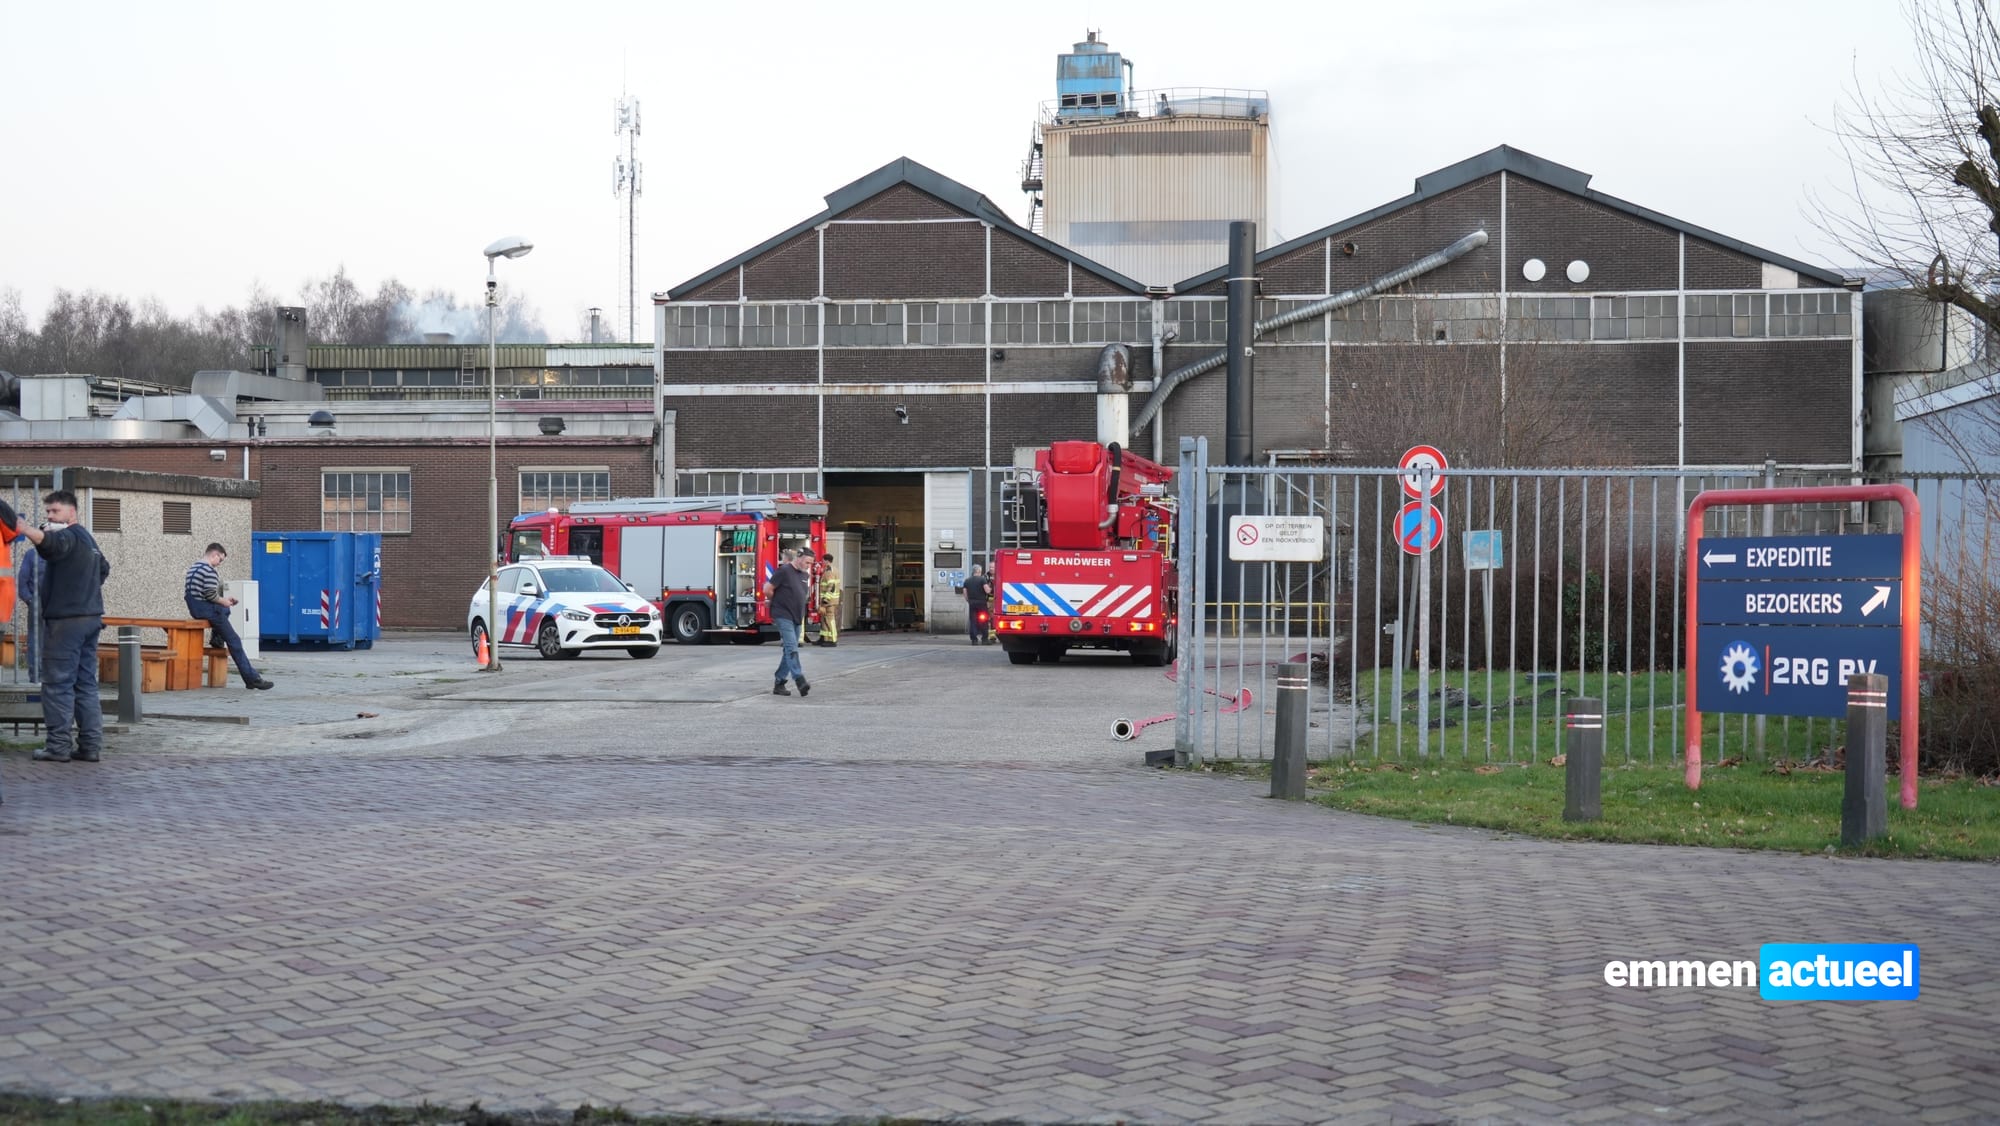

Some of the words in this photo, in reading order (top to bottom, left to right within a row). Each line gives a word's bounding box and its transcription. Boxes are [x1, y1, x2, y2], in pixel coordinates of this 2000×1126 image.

[1043, 557, 1111, 567] BRANDWEER
[1746, 547, 1832, 567] EXPEDITIE
[1746, 593, 1843, 614] BEZOEKERS
[1773, 657, 1829, 685] 2RG
